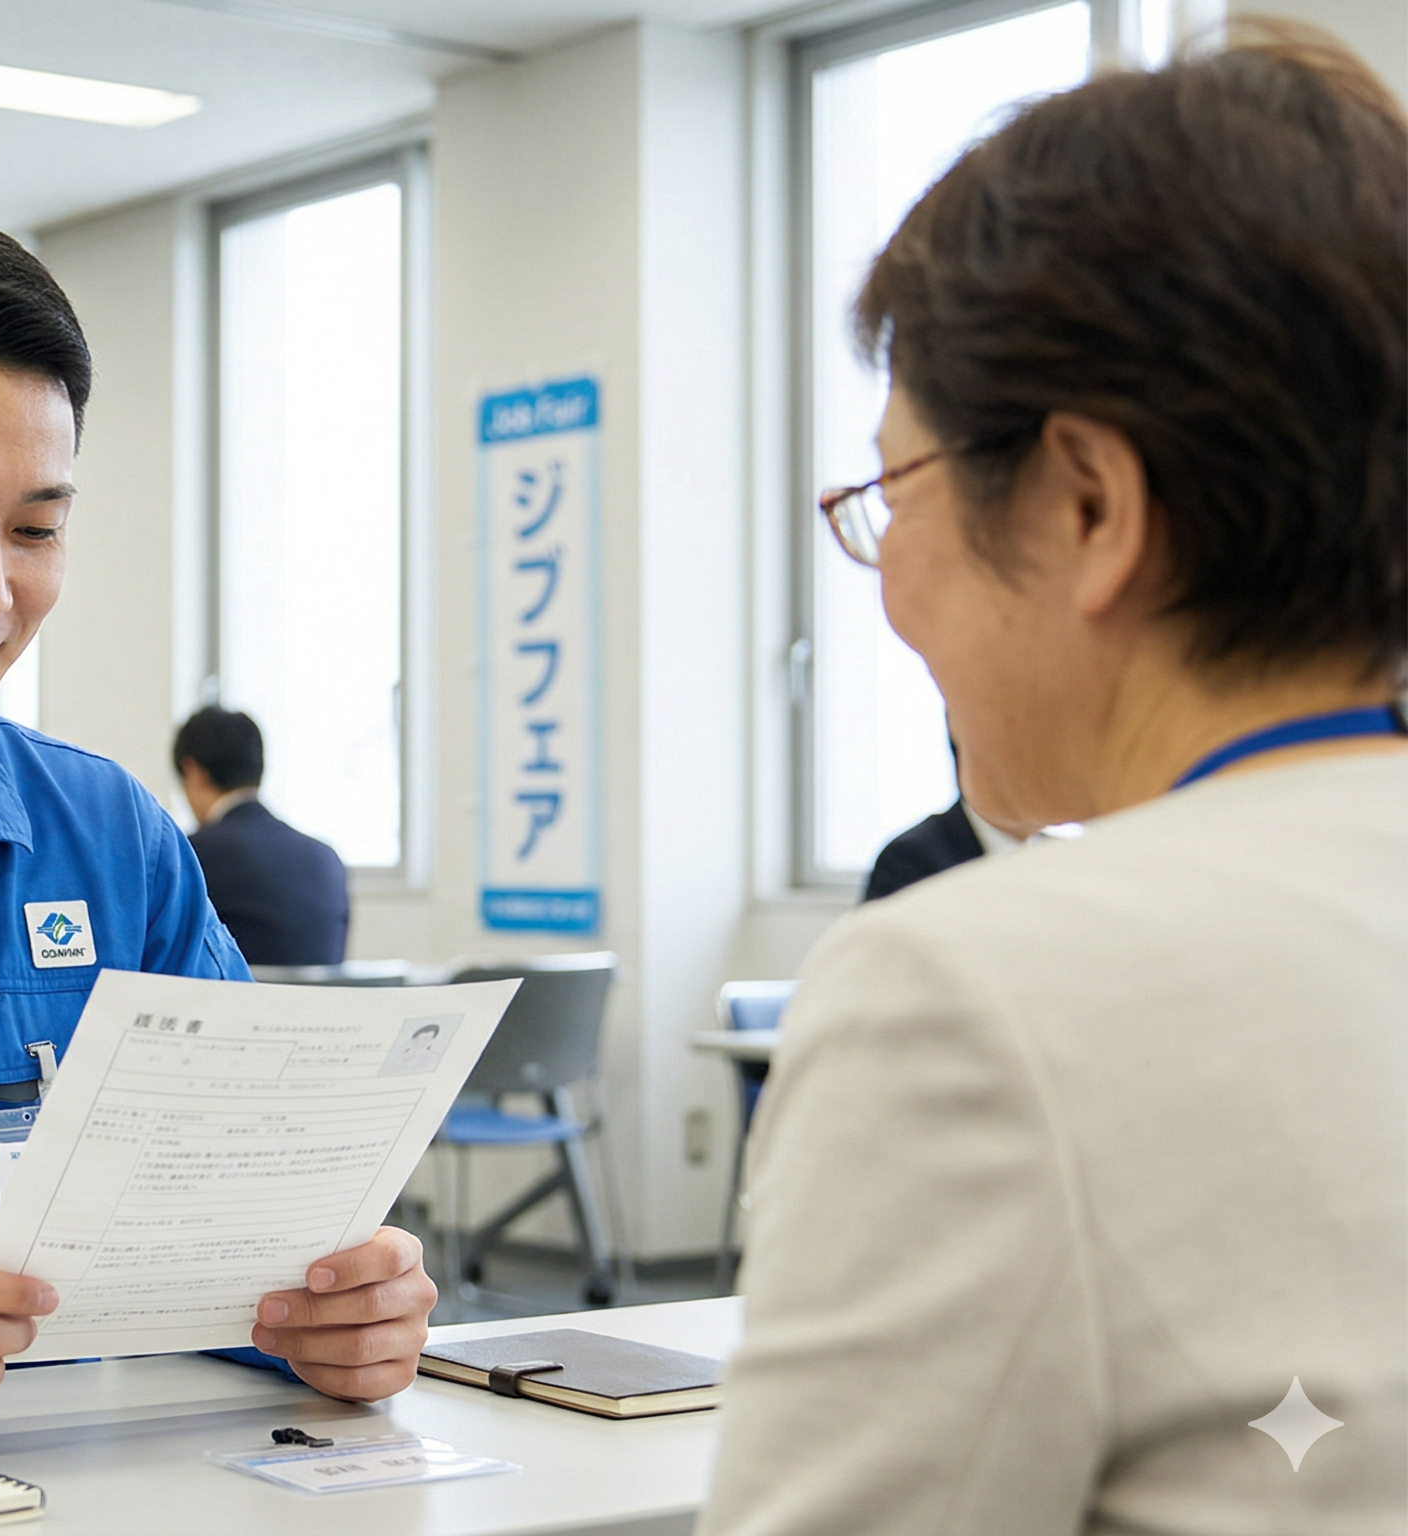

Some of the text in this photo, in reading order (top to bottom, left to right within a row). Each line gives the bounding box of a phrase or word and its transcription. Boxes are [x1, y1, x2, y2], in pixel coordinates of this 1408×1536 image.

[514, 462, 563, 861] ジブフェア
